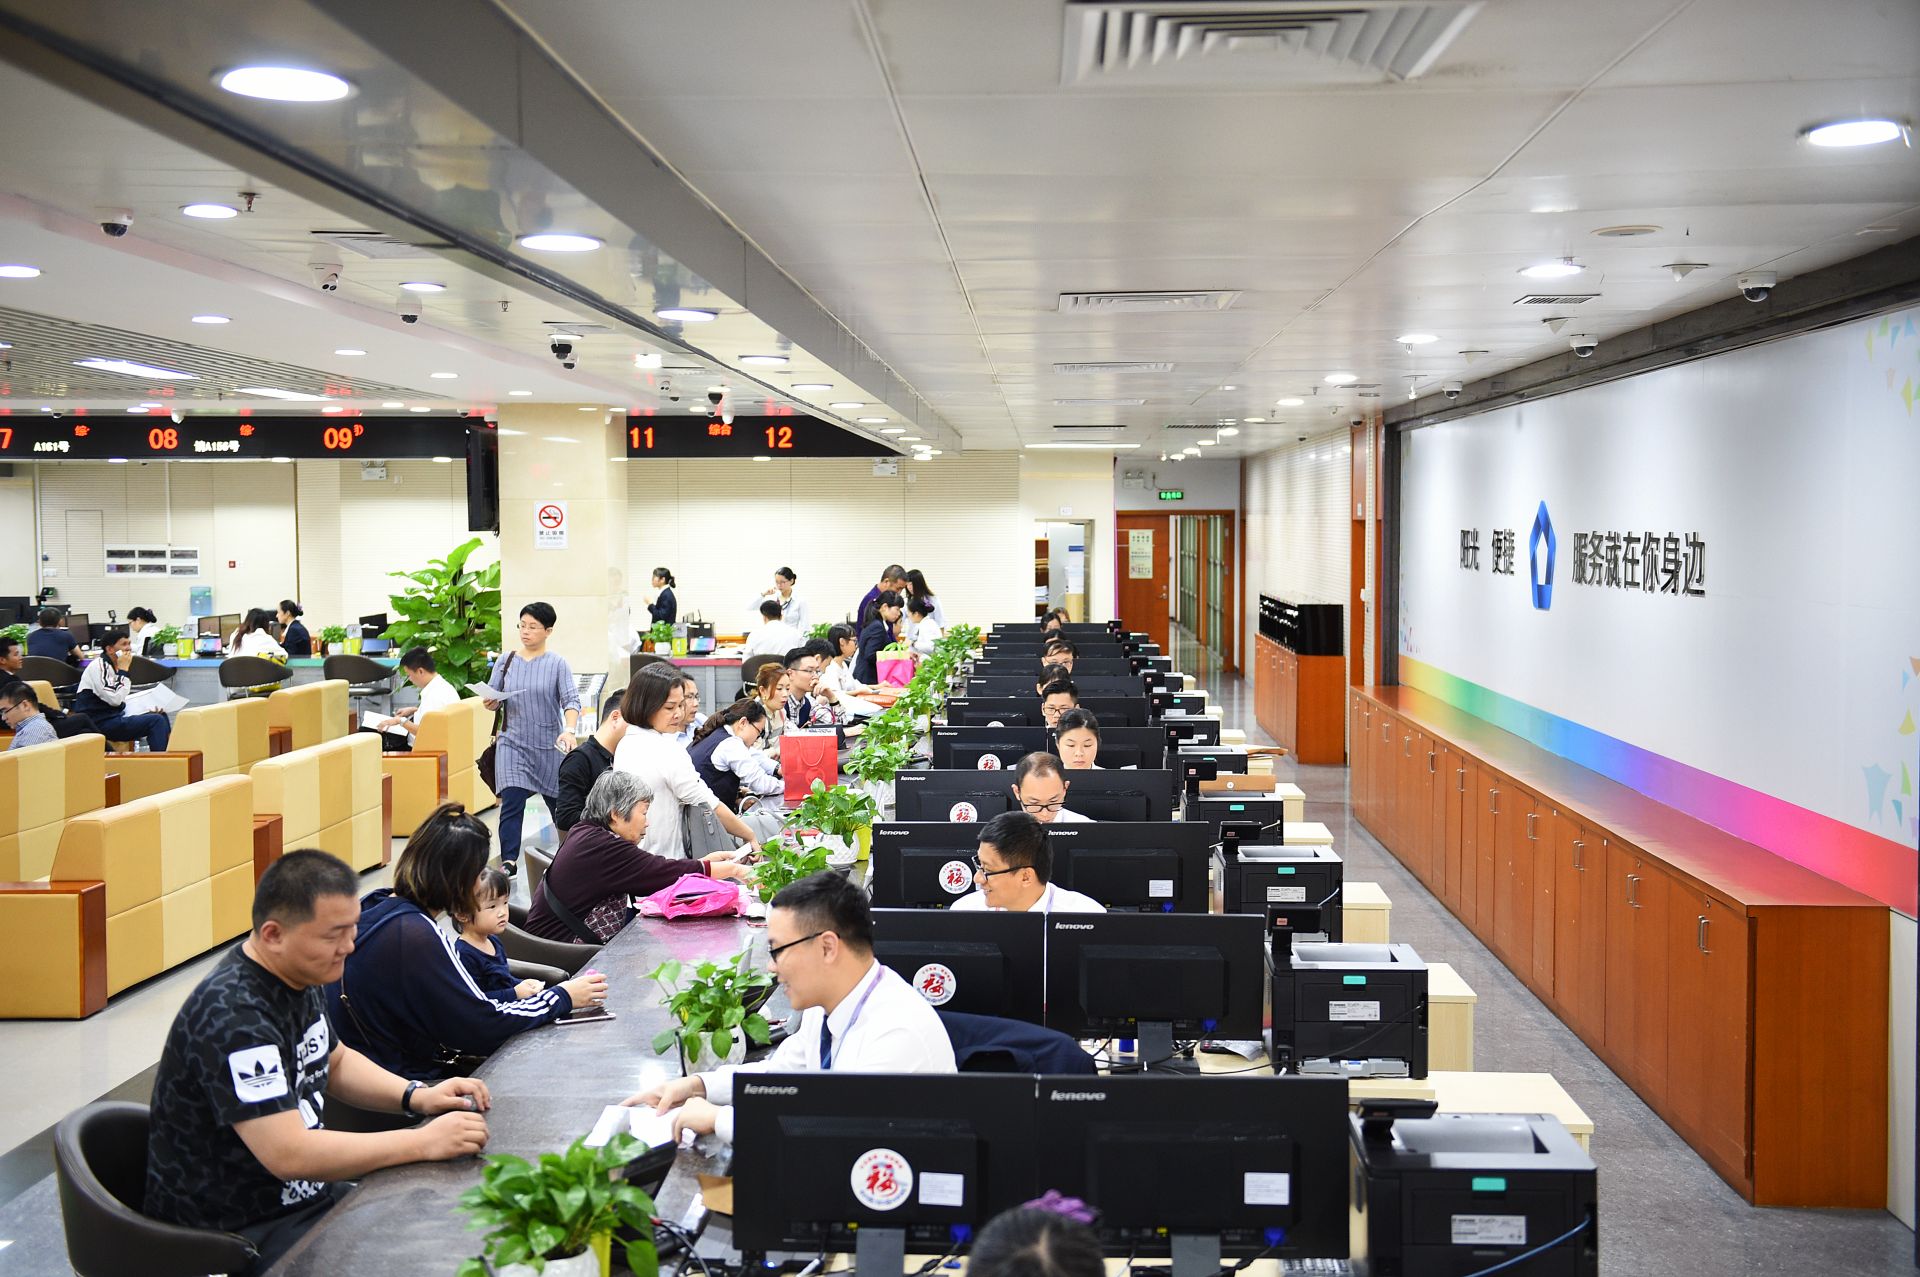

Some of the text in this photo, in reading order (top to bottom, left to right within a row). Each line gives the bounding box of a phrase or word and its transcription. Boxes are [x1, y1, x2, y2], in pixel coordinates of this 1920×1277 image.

[148, 427, 178, 450] 08
[323, 427, 353, 450] 09
[629, 426, 655, 449] 11
[708, 423, 733, 437] 综合
[765, 426, 794, 449] 12
[1460, 528, 1706, 598] 阳光 便捷 服务就在你身边
[1047, 829, 1079, 837] lenovo
[1055, 922, 1095, 930] lenovo
[743, 1083, 799, 1096] lenovo
[1051, 1090, 1107, 1102] lenovo
